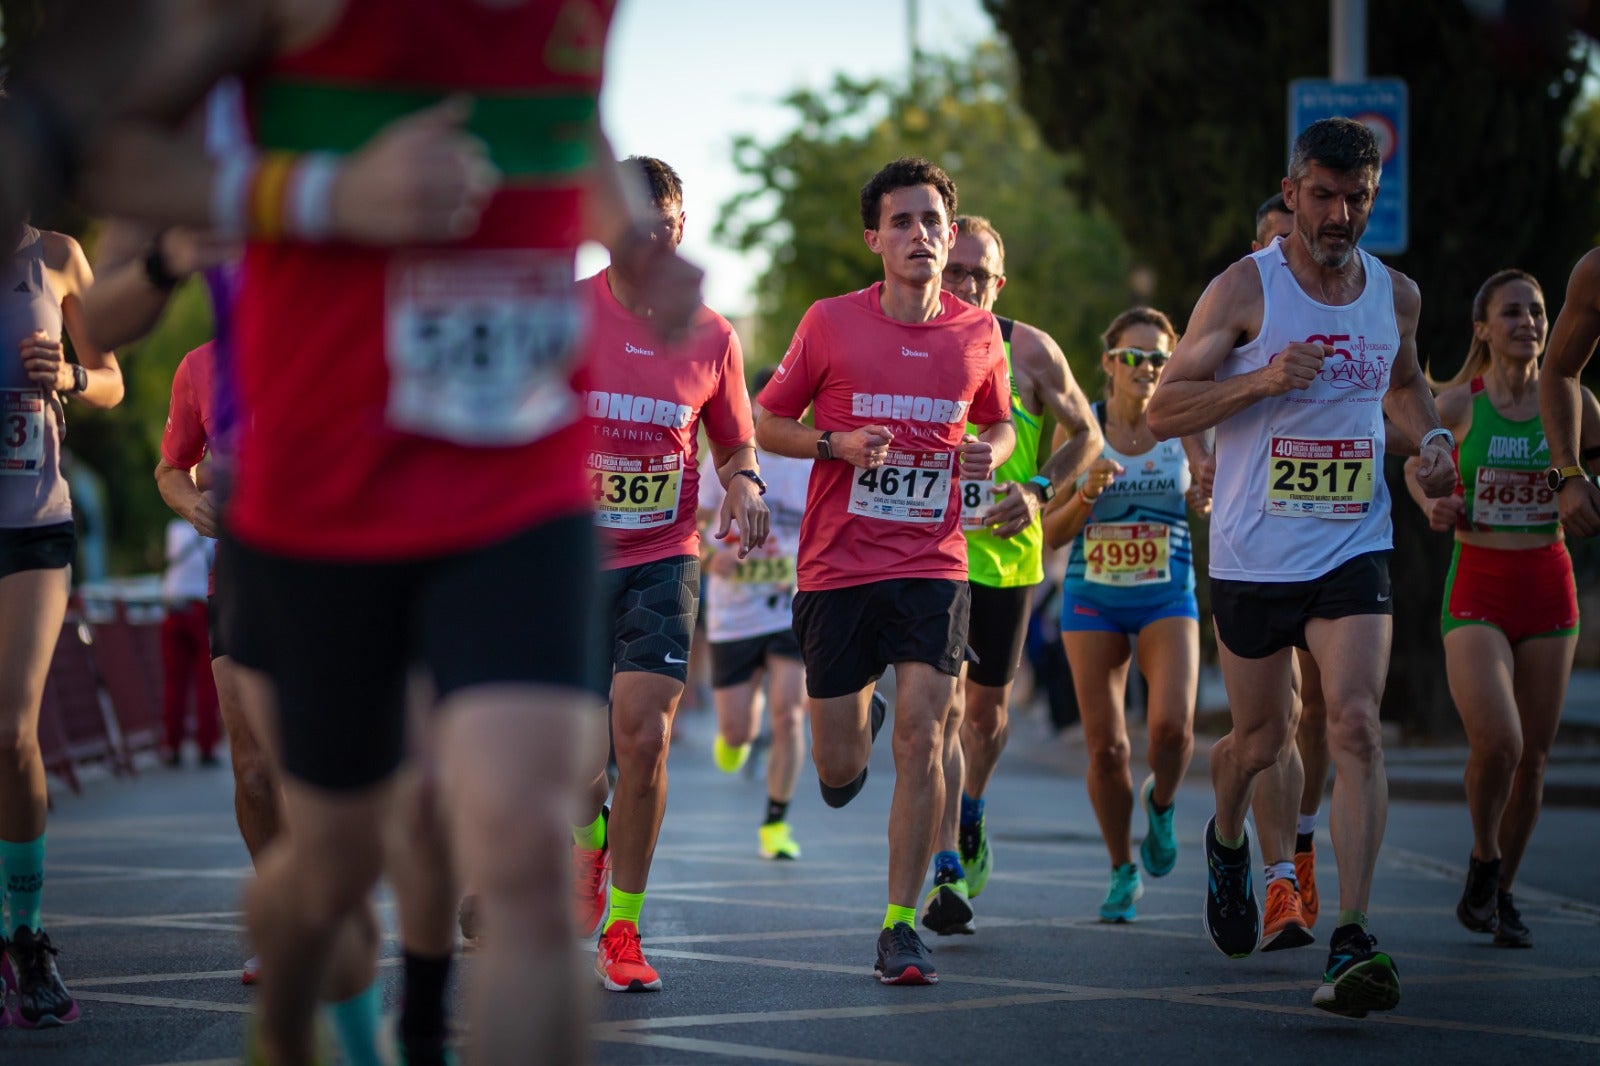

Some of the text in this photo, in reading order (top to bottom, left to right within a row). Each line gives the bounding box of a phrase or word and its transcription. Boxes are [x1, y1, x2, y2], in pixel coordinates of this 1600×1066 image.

[584, 390, 693, 430] ONOBO
[852, 392, 968, 424] BONOBO
[593, 425, 664, 441] TRAINING
[1275, 440, 1292, 456] 40
[1487, 435, 1530, 459] ATARFE
[587, 452, 602, 469] 40
[590, 472, 670, 504] 4367
[858, 468, 940, 498] 4617
[1103, 479, 1176, 492] ARACENA
[1273, 460, 1362, 492] 2517
[964, 483, 981, 508] 8
[1479, 486, 1553, 505] 4639
[1088, 541, 1158, 566] 4999
